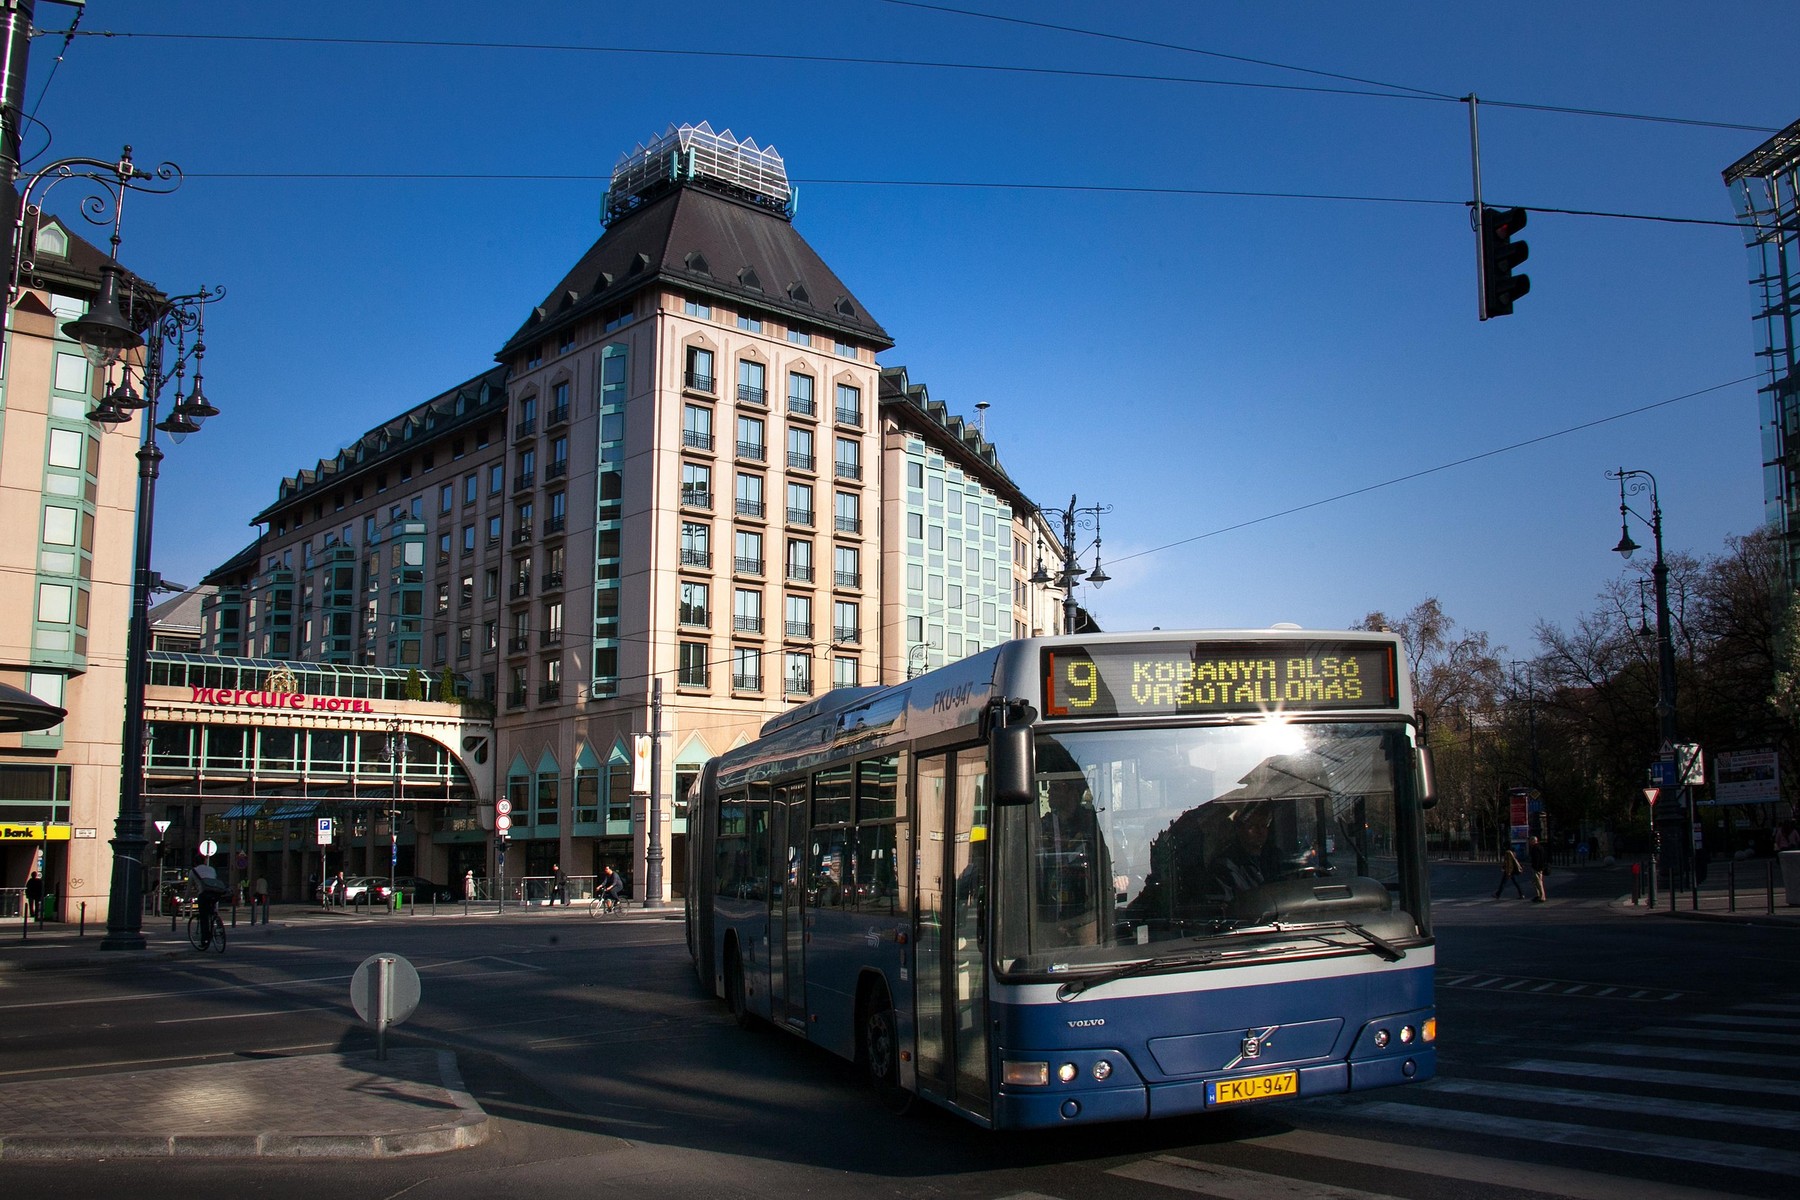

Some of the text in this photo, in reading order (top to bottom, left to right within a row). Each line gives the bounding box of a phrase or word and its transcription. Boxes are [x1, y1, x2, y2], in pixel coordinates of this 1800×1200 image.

[1286, 656, 1360, 678] ALSÓ
[1068, 662, 1097, 707] 9
[1131, 679, 1362, 705] VASÚTÁLLOMÁS
[312, 696, 374, 713] HOTEL
[932, 681, 974, 714] FKU-947
[4, 827, 33, 838] Bank
[321, 821, 329, 830] P
[1067, 1018, 1105, 1028] VOLVO
[1219, 1075, 1292, 1101] FKU-947
